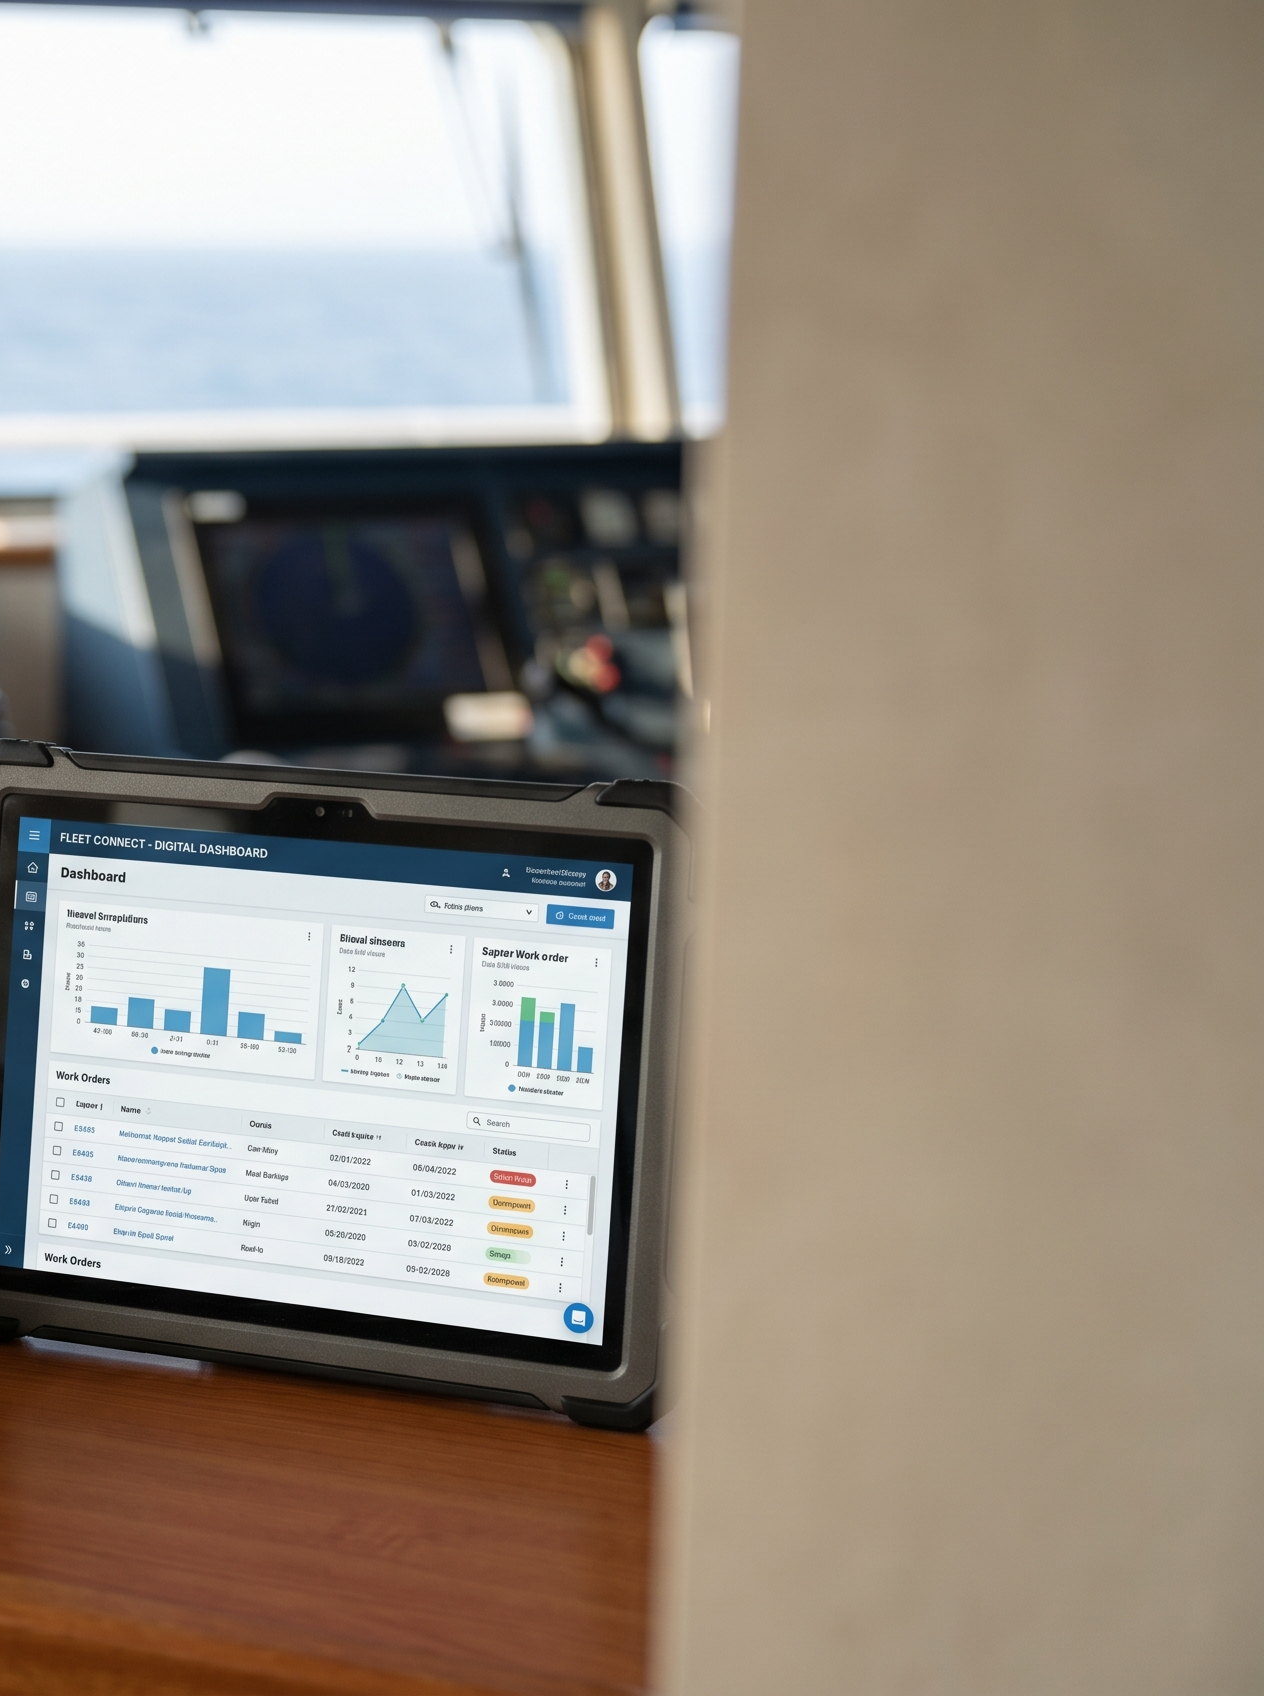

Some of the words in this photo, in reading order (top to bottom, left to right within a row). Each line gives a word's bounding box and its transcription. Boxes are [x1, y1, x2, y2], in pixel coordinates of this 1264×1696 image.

[60, 832, 91, 845] FLEET
[94, 835, 145, 849] CONNECT
[155, 840, 197, 854] DIGITAL
[199, 843, 268, 859] DASHBOARD
[61, 866, 127, 883] Dashboard
[515, 949, 540, 961] Work
[56, 1070, 79, 1082] Work
[81, 1073, 111, 1085] Orders
[120, 1105, 142, 1114] Name
[486, 1119, 511, 1128] Search
[329, 1154, 372, 1166] 02/01/2022
[412, 1163, 457, 1176] 06/04/2022
[411, 1189, 456, 1201] 01/03/2022
[409, 1214, 454, 1227] 07/03/2022
[44, 1252, 68, 1264] Work
[70, 1256, 102, 1269] Orders
